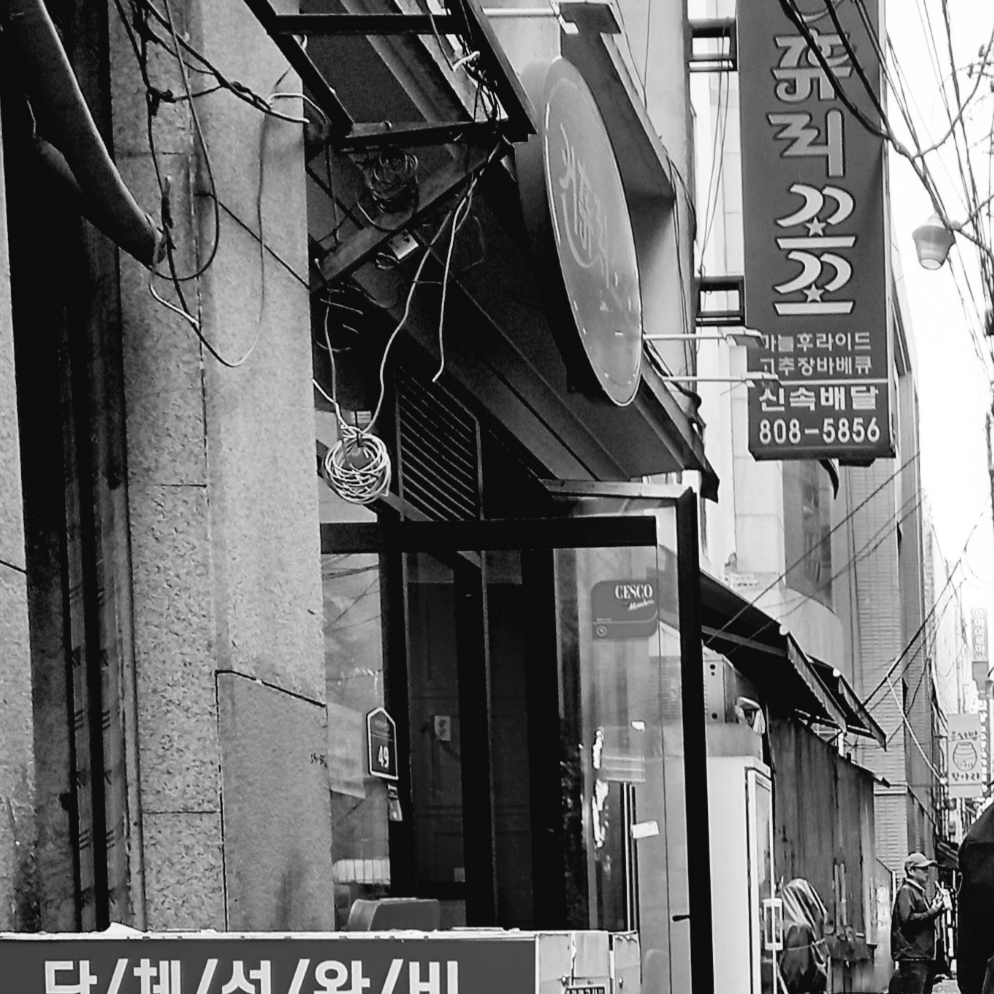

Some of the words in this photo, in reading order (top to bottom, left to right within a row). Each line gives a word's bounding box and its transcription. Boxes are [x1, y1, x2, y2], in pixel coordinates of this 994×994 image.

[759, 385, 879, 411] 신속배달
[760, 417, 880, 443] 808-5856
[615, 583, 654, 599] CESCO
[378, 745, 389, 768] 49
